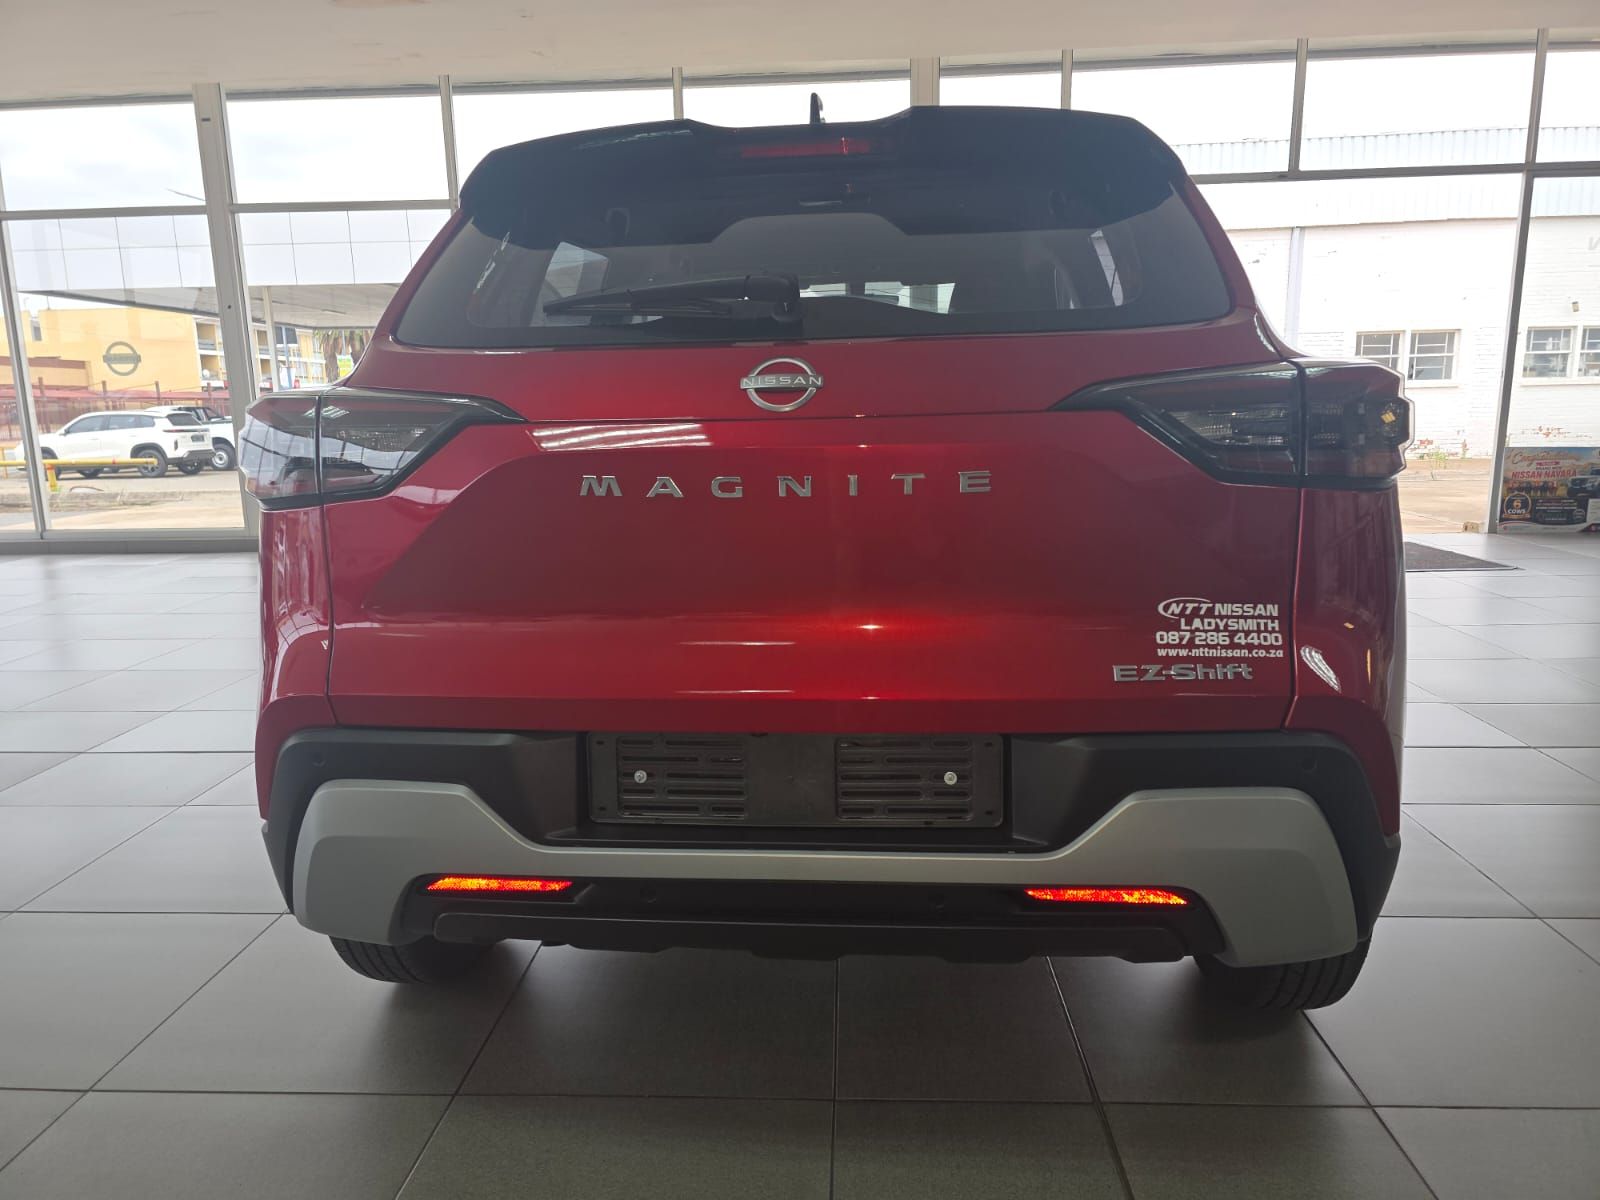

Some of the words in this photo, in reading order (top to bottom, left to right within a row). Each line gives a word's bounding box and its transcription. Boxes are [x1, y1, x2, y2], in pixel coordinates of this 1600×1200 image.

[742, 376, 822, 386] NISSAN
[1511, 471, 1541, 479] NISSAN
[1544, 469, 1577, 478] NAVARA
[579, 470, 992, 498] MAGNITE
[1167, 603, 1213, 615] NTT
[1214, 603, 1279, 617] NISSAN
[1180, 618, 1280, 631] LADYSMITH
[1155, 631, 1190, 644] 087
[1194, 632, 1230, 645] 286
[1233, 633, 1283, 646] 4400
[1157, 646, 1284, 658] www.nttnissan.co.za
[1112, 663, 1253, 682] EZ-Shift
